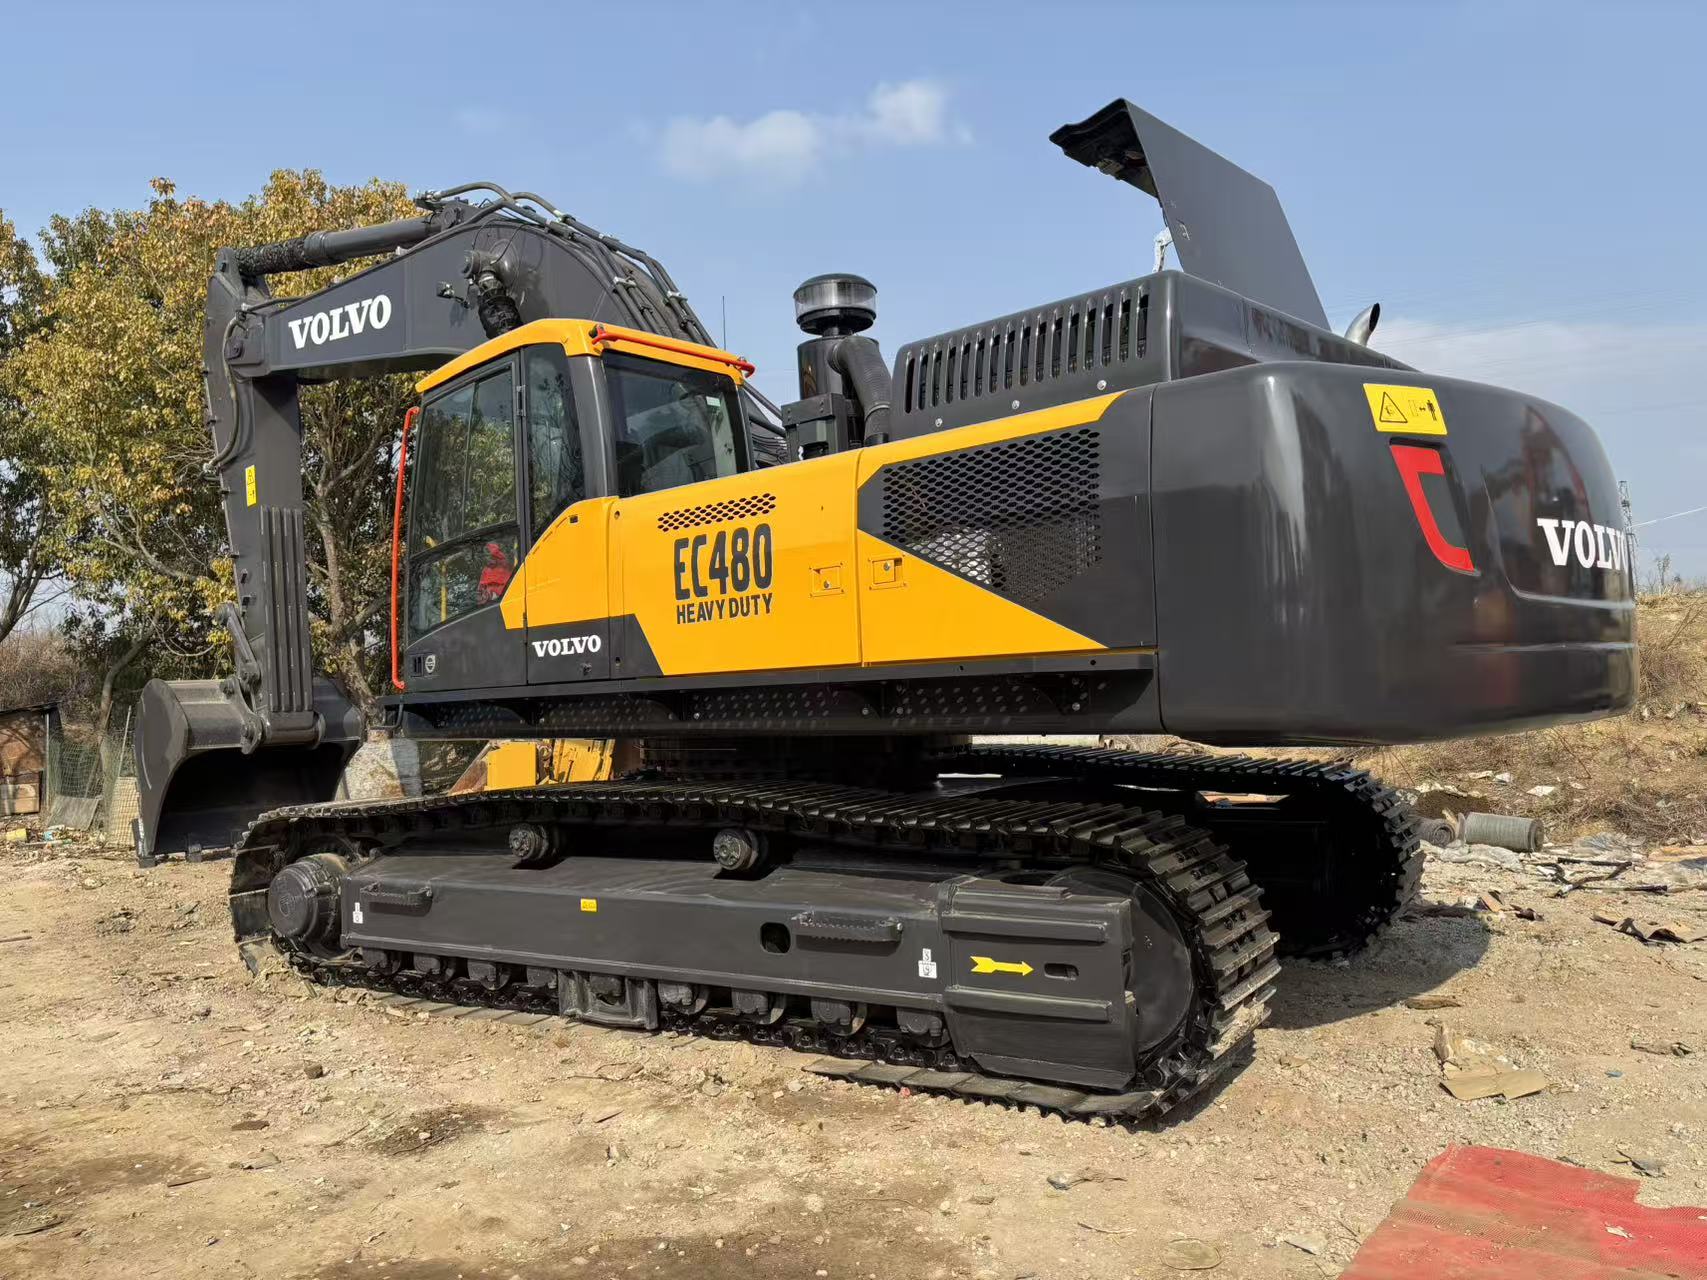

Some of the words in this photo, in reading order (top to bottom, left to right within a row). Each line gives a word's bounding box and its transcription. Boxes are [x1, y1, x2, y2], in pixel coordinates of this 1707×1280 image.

[288, 294, 392, 349] VOLVO
[674, 523, 773, 600] EC480
[676, 599, 725, 624] HEAVY
[728, 593, 773, 618] DUTY
[532, 634, 601, 657] VOLVO
